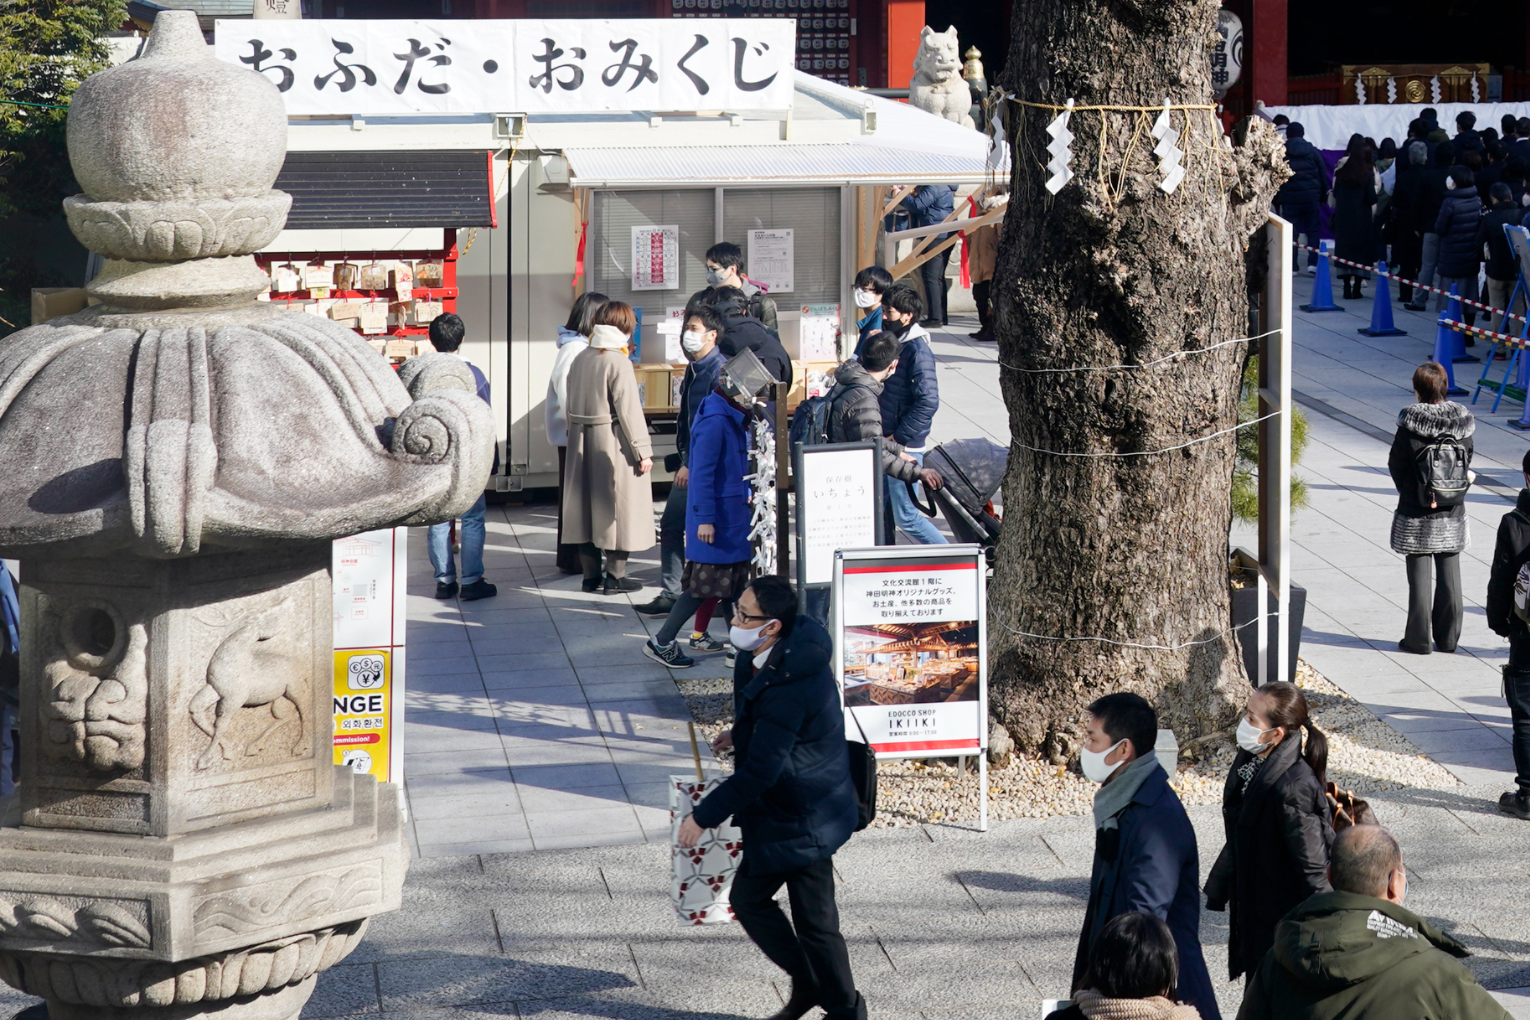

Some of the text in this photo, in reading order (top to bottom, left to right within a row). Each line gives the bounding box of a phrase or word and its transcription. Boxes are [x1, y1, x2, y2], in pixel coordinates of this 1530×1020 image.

[238, 33, 779, 97] おふだ・おみくじ
[813, 486, 865, 498] いちょう
[888, 709, 937, 718] EDOCCO SHOP
[889, 718, 936, 729] IKIIKI
